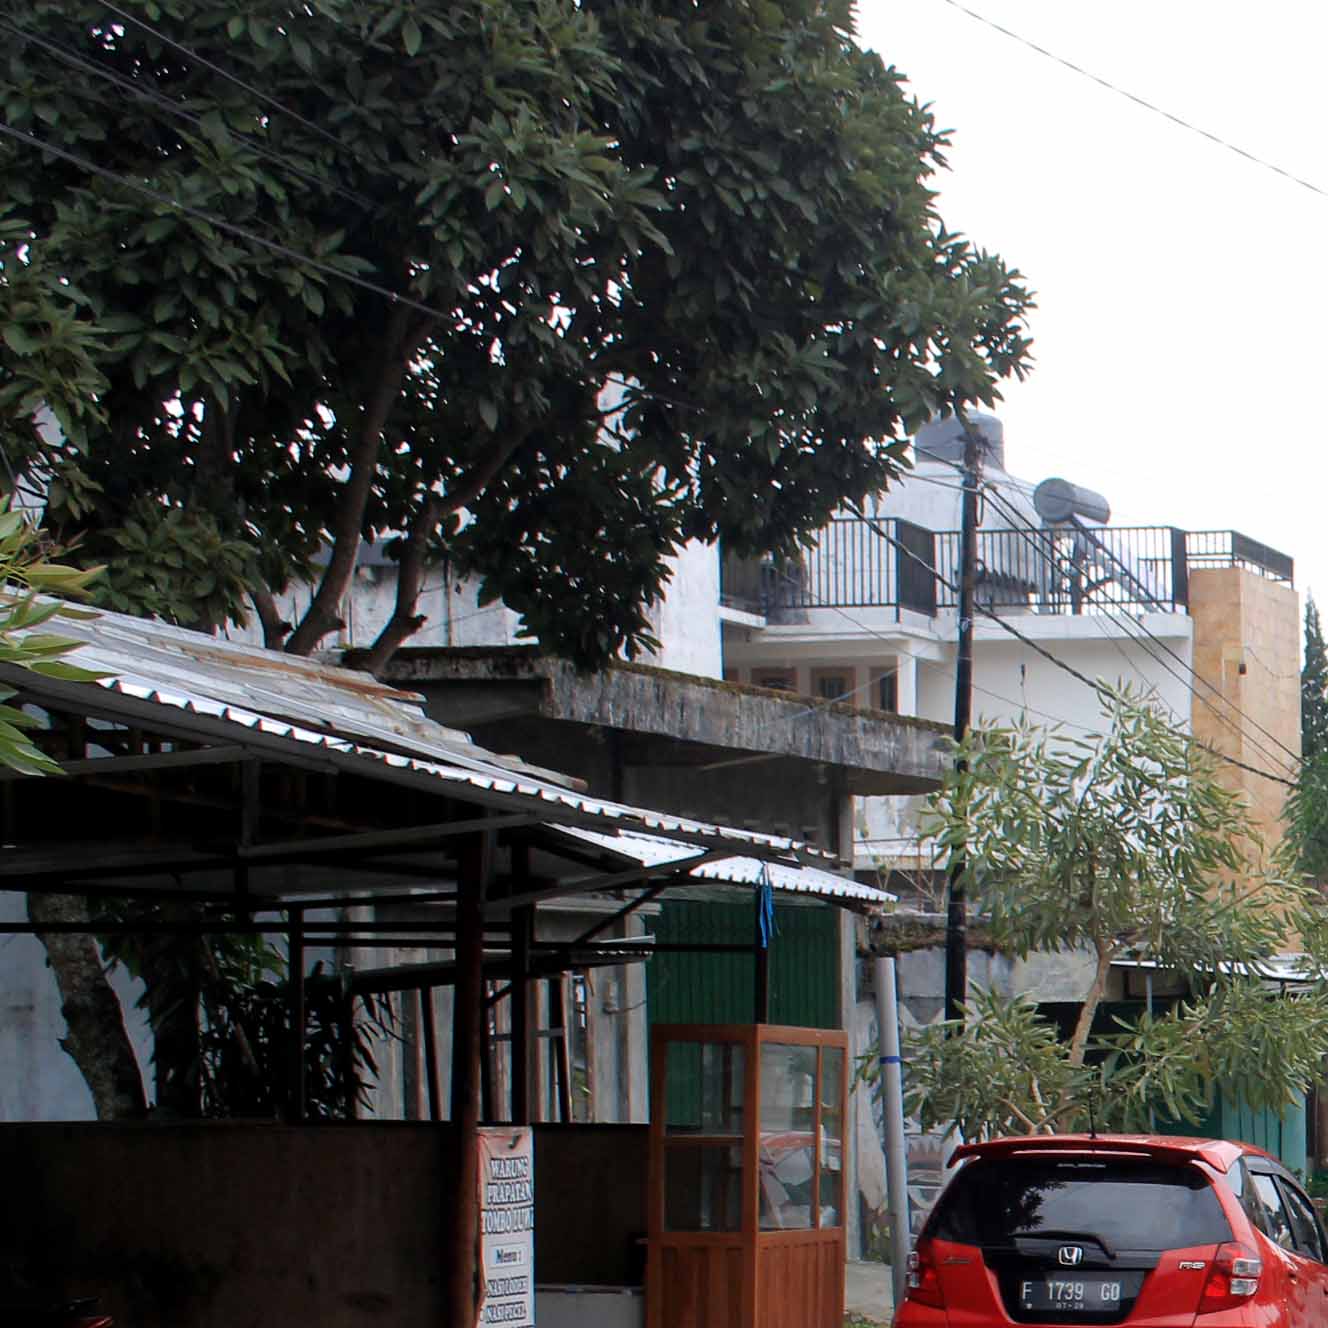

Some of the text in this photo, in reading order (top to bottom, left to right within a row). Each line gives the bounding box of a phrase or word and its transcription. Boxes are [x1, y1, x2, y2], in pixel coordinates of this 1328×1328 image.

[490, 1157, 528, 1179] WARUNG
[1022, 1282, 1032, 1299] F
[1048, 1282, 1083, 1300] 1739
